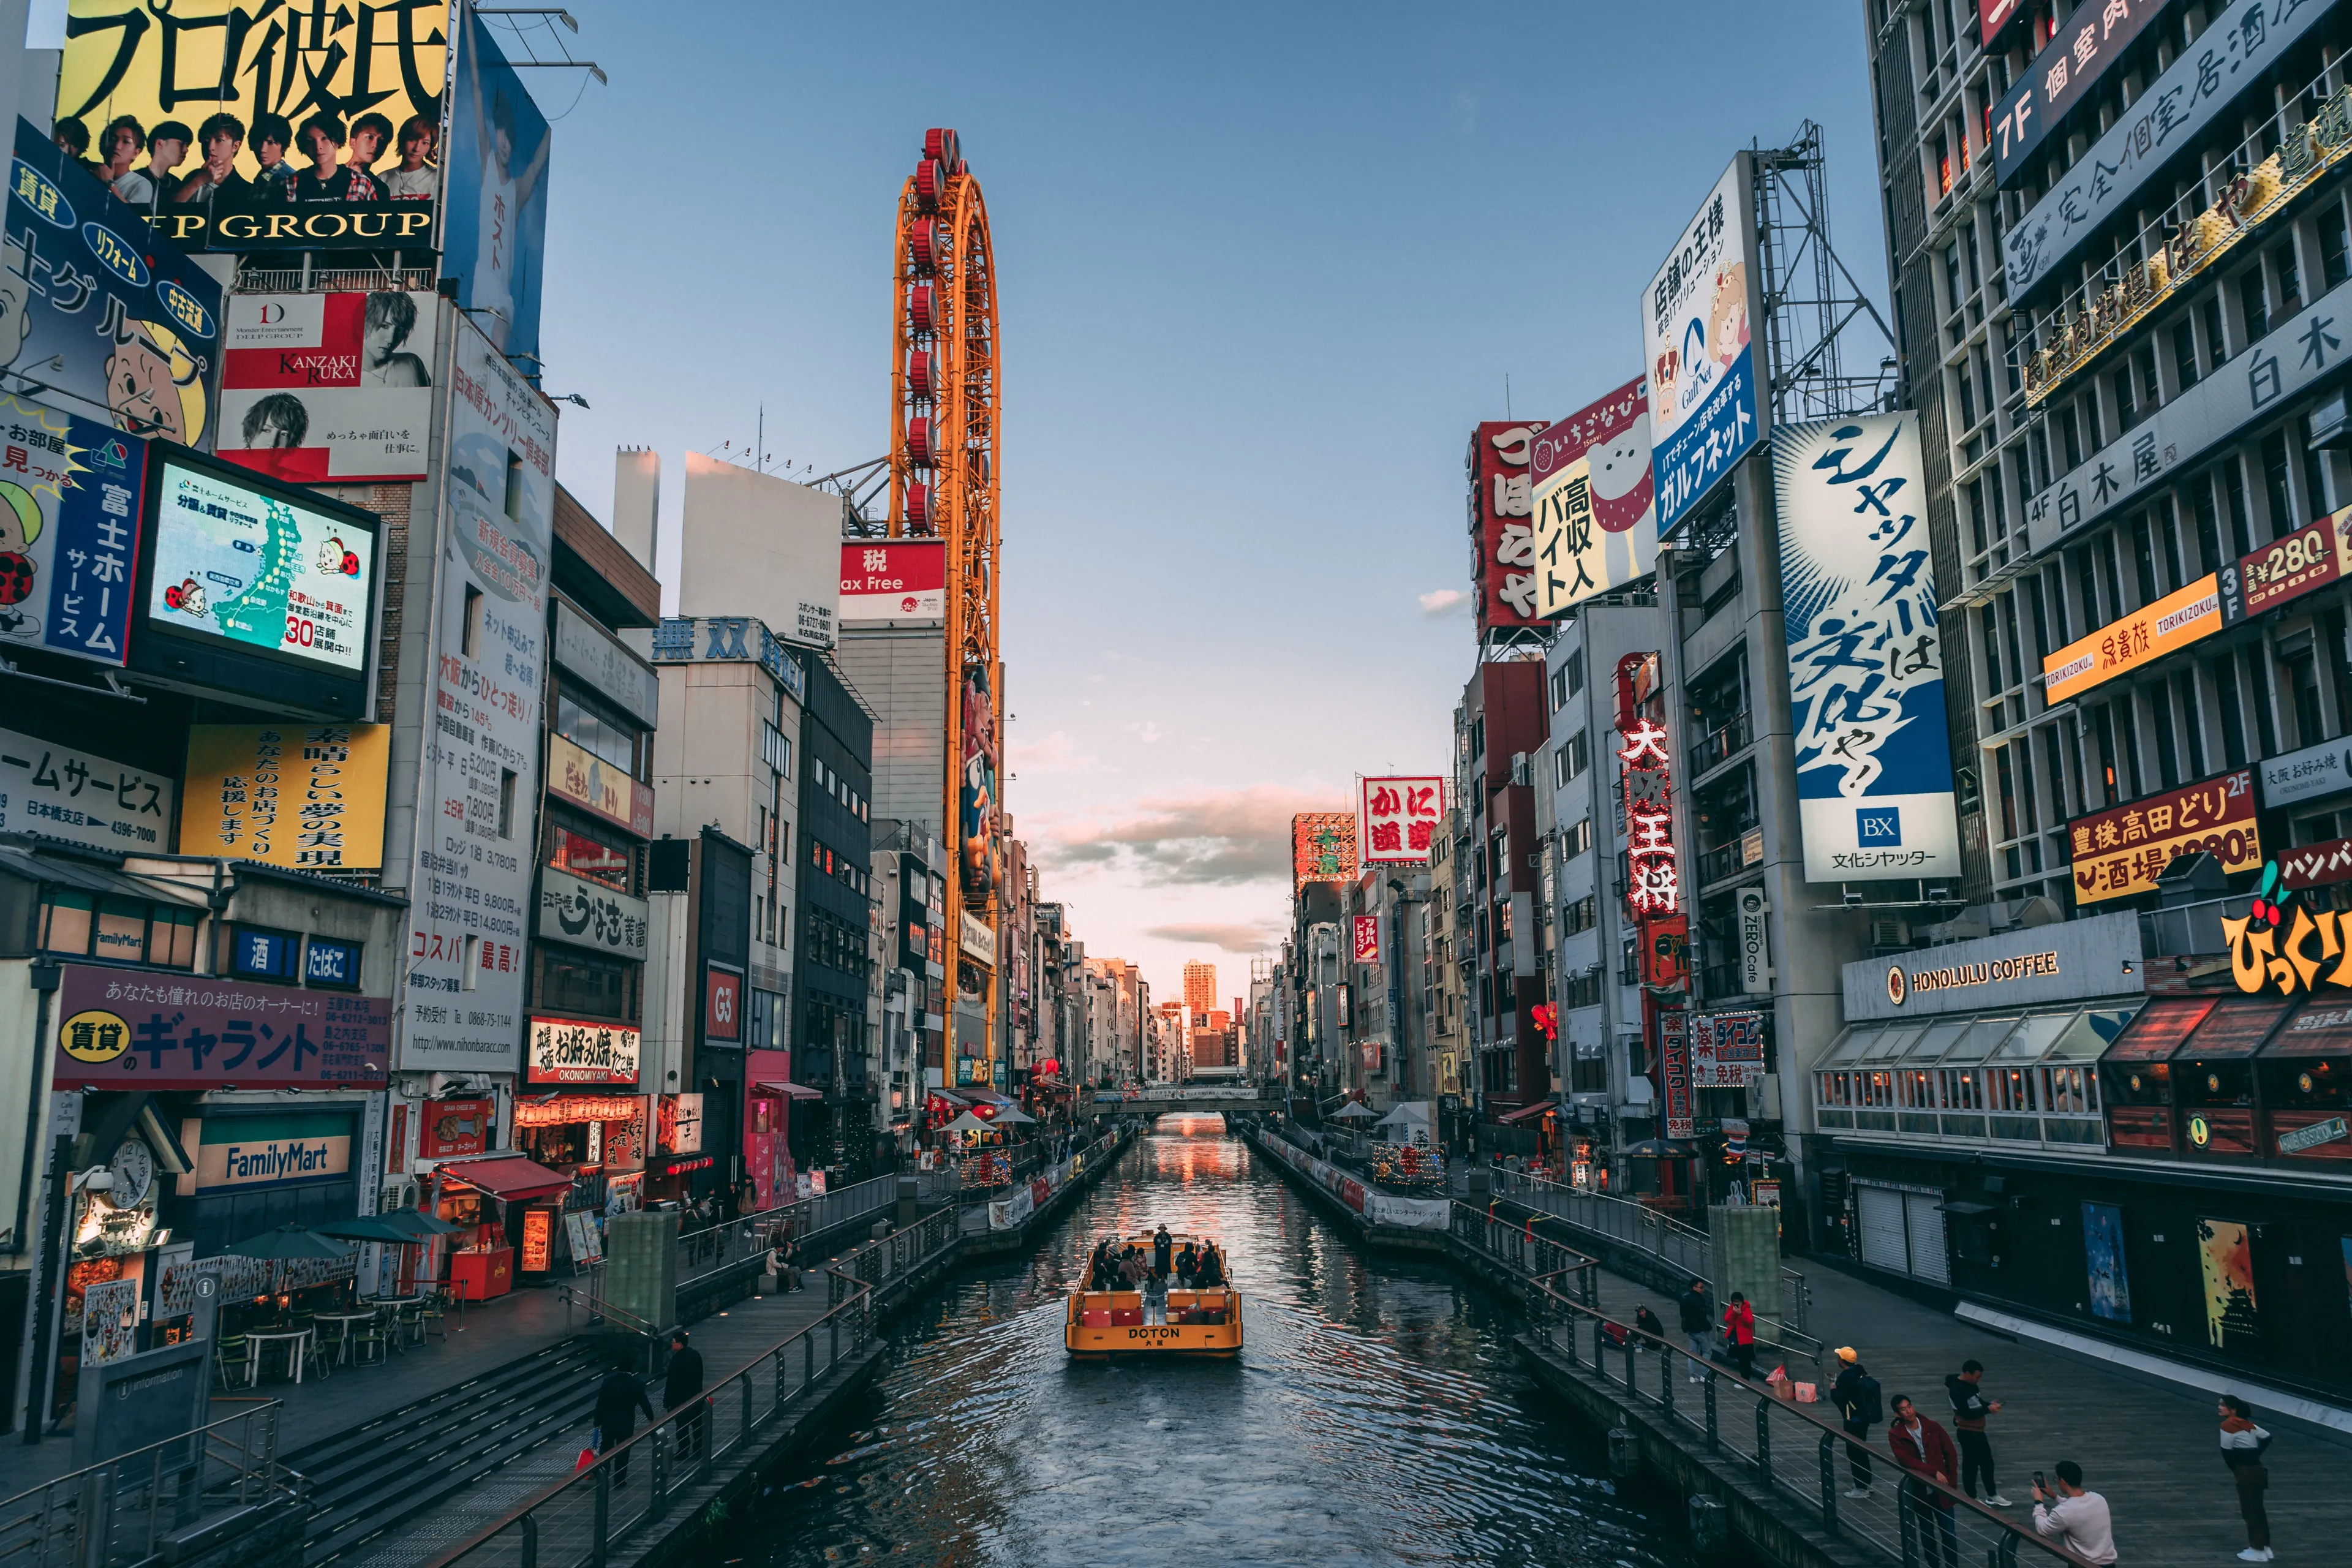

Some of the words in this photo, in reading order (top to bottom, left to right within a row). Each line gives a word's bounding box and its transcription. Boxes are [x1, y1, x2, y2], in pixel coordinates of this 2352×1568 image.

[67, 0, 446, 121] プロ彼氏
[1997, 89, 2031, 160] 7F
[19, 167, 58, 221] 賃貸
[219, 213, 430, 238] GROUP
[491, 193, 506, 271] ホスト
[97, 229, 137, 282] リフォーム
[1654, 193, 1724, 323] 店舗の王様
[168, 287, 203, 333] 中古流通
[279, 353, 356, 374] KANZAKI
[307, 367, 355, 384] RUKA
[2248, 316, 2340, 411] 白木
[327, 429, 410, 440] めっちゃ面白いを
[456, 365, 549, 477] 日本原カンツリー倶楽部
[1553, 393, 1635, 453] いちごなび
[1583, 434, 1602, 448] 15navi
[1660, 399, 1751, 524] ガルフネット
[2031, 493, 2051, 522] 4F
[2059, 432, 2161, 532] 白木屋
[1539, 487, 1566, 607] バイト
[1564, 473, 1594, 597] 高収入
[85, 483, 132, 653] 富士ホーム
[863, 549, 887, 572] 税
[59, 548, 88, 637] サービス
[841, 579, 861, 590] ax
[867, 576, 903, 590] Free
[2245, 564, 2257, 594] 全品
[798, 614, 831, 631] 06-6727-0601
[799, 602, 831, 617] スポンサー募集中
[2157, 598, 2212, 633] TORIKIZOKU
[285, 616, 313, 647] 30
[314, 625, 336, 639] 店舗
[2046, 657, 2088, 687] TORIKIZOKU
[470, 752, 497, 781] 5,200円
[2267, 769, 2290, 786] 大阪
[2293, 753, 2338, 778] お好み焼
[251, 731, 282, 856] あなたのお店づくり
[295, 728, 351, 867] 素晴らしい夢の実現
[1370, 786, 1436, 816] かに
[2280, 777, 2326, 795] OKONOMI-YAKI
[28, 800, 85, 826] 日本橋支店
[111, 821, 156, 842] 4396-7000
[218, 776, 249, 846] 応援します
[444, 797, 464, 820] 土日祝
[467, 795, 494, 824] 7,800円
[1619, 719, 1678, 911] 大阪王将
[2073, 786, 2226, 858] 豊後高田どり
[2227, 772, 2250, 797] 2F
[1371, 820, 1438, 851] 道楽
[1863, 818, 1896, 836] BX
[446, 837, 466, 855] ロッジ
[470, 844, 481, 861] 1泊
[488, 851, 516, 873] 3,780円
[2101, 847, 2166, 892] 酒場
[465, 886, 480, 905] 平日
[463, 910, 478, 928] 平日
[559, 885, 624, 946] うなぎ
[624, 915, 646, 949] 菱富
[1365, 919, 1376, 944] ツルハ
[96, 929, 141, 948] FamilyMart
[413, 931, 462, 963] コスパ
[1357, 923, 1365, 951] ドラッグ
[1744, 916, 1759, 954] ZERO
[252, 937, 270, 970] 酒
[309, 947, 344, 979] たばこ
[1747, 955, 1757, 982] cafe
[1912, 962, 1989, 992] HONOLULU
[1991, 951, 2059, 981] COFFEE
[326, 1012, 387, 1025] 06-6212-3013
[415, 1005, 447, 1025] 予約受付
[469, 1011, 511, 1028] 0868-75-1144
[715, 986, 732, 1023] G3
[70, 1022, 123, 1052] 賃貸
[132, 1012, 318, 1071] ギャラント
[323, 1041, 385, 1053] 06-6765-1306
[412, 1034, 511, 1054] http://www.nihonbaracc.com
[556, 1027, 611, 1066] お好み焼
[1697, 1024, 1714, 1060] 薬
[1717, 1020, 1758, 1047] ダイコク
[540, 1049, 553, 1073] 大阪
[559, 1070, 607, 1080] OKONOMIYAKI
[612, 1047, 634, 1078] たこ焼
[960, 1060, 971, 1071] 薬
[995, 1063, 1005, 1073] 薬
[1667, 1036, 1686, 1089] ダイコク
[1716, 1064, 1743, 1084] 免税
[1668, 1120, 1692, 1130] 免税
[2309, 1122, 2333, 1143] STATION
[125, 1144, 133, 1155] 12
[139, 1155, 146, 1164] 2
[227, 1143, 328, 1178] FamilyMart
[136, 1178, 142, 1188] 4
[140, 1167, 146, 1177] 3
[122, 1193, 127, 1203] 6
[1129, 1328, 1180, 1338] DOTON
